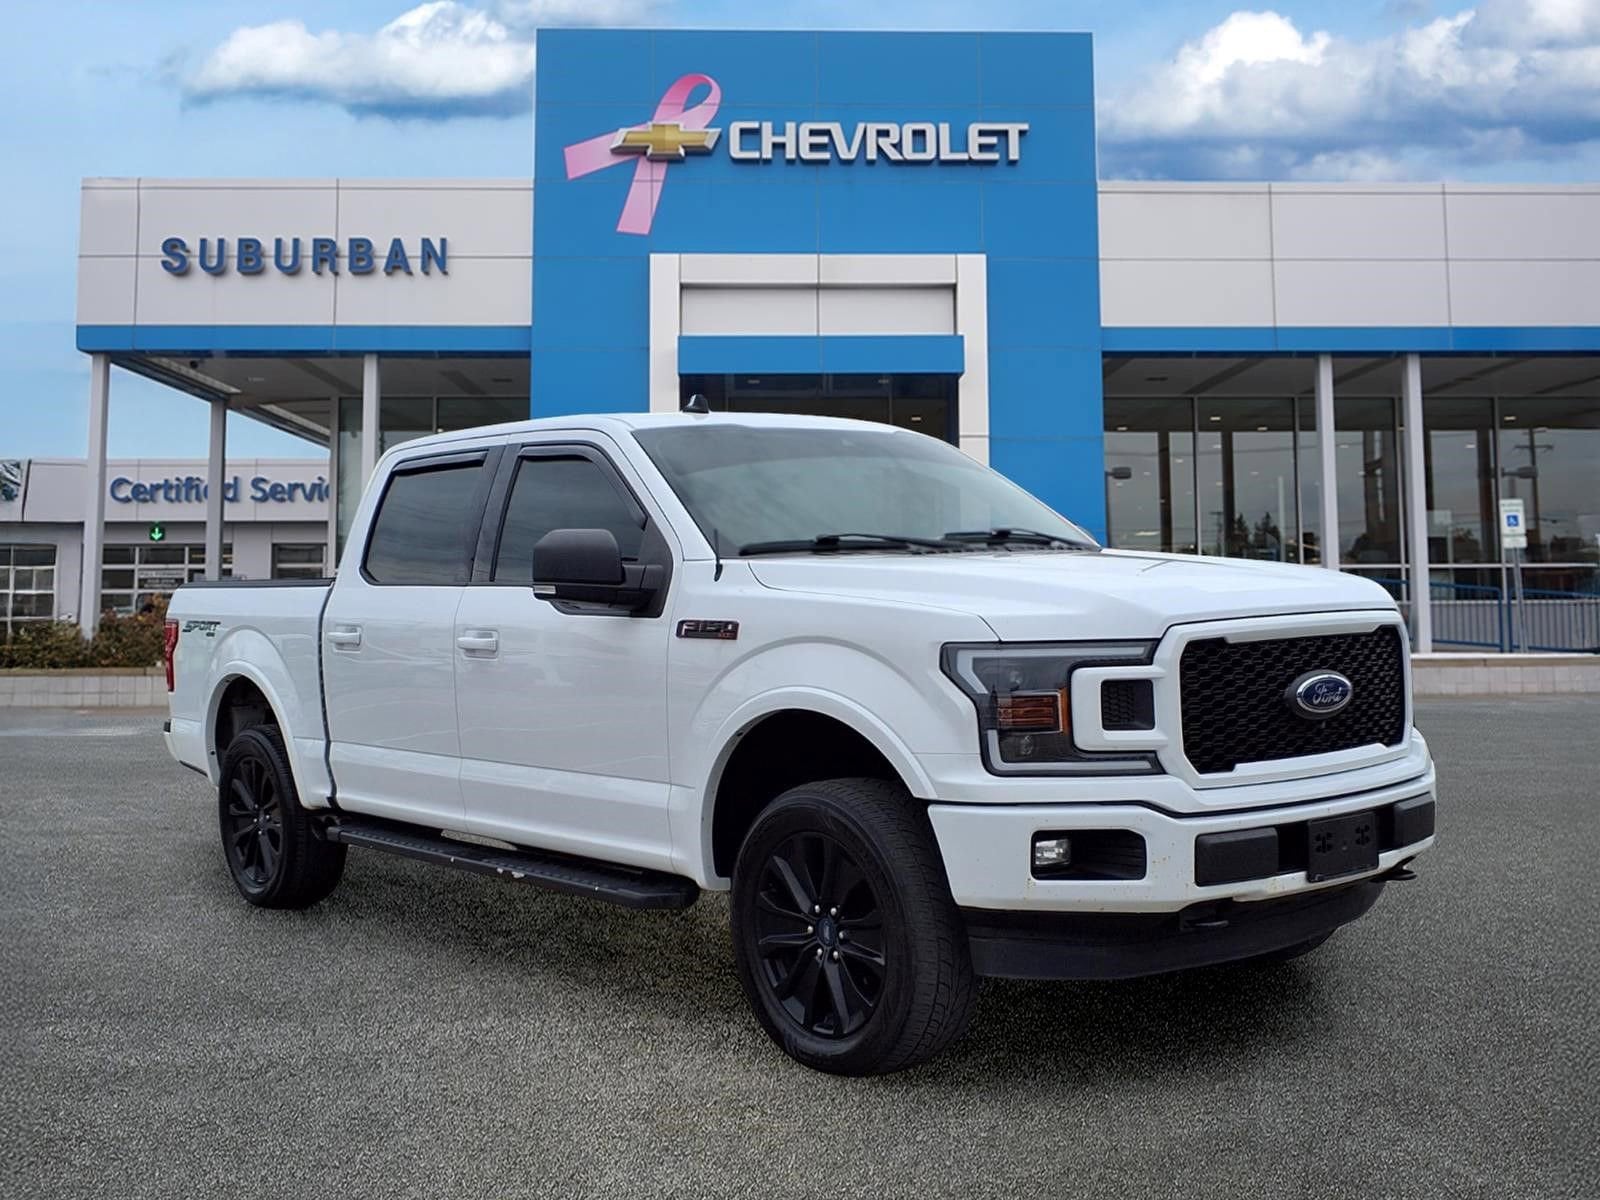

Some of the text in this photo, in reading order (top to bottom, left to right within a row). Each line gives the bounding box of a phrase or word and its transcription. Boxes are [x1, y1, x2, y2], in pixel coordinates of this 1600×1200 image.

[728, 121, 1029, 162] CHEVROLET
[160, 237, 449, 276] SUBURBAN
[110, 476, 329, 503] Certifid Servi
[182, 620, 221, 632] SPORT
[1312, 682, 1343, 704] Ford
